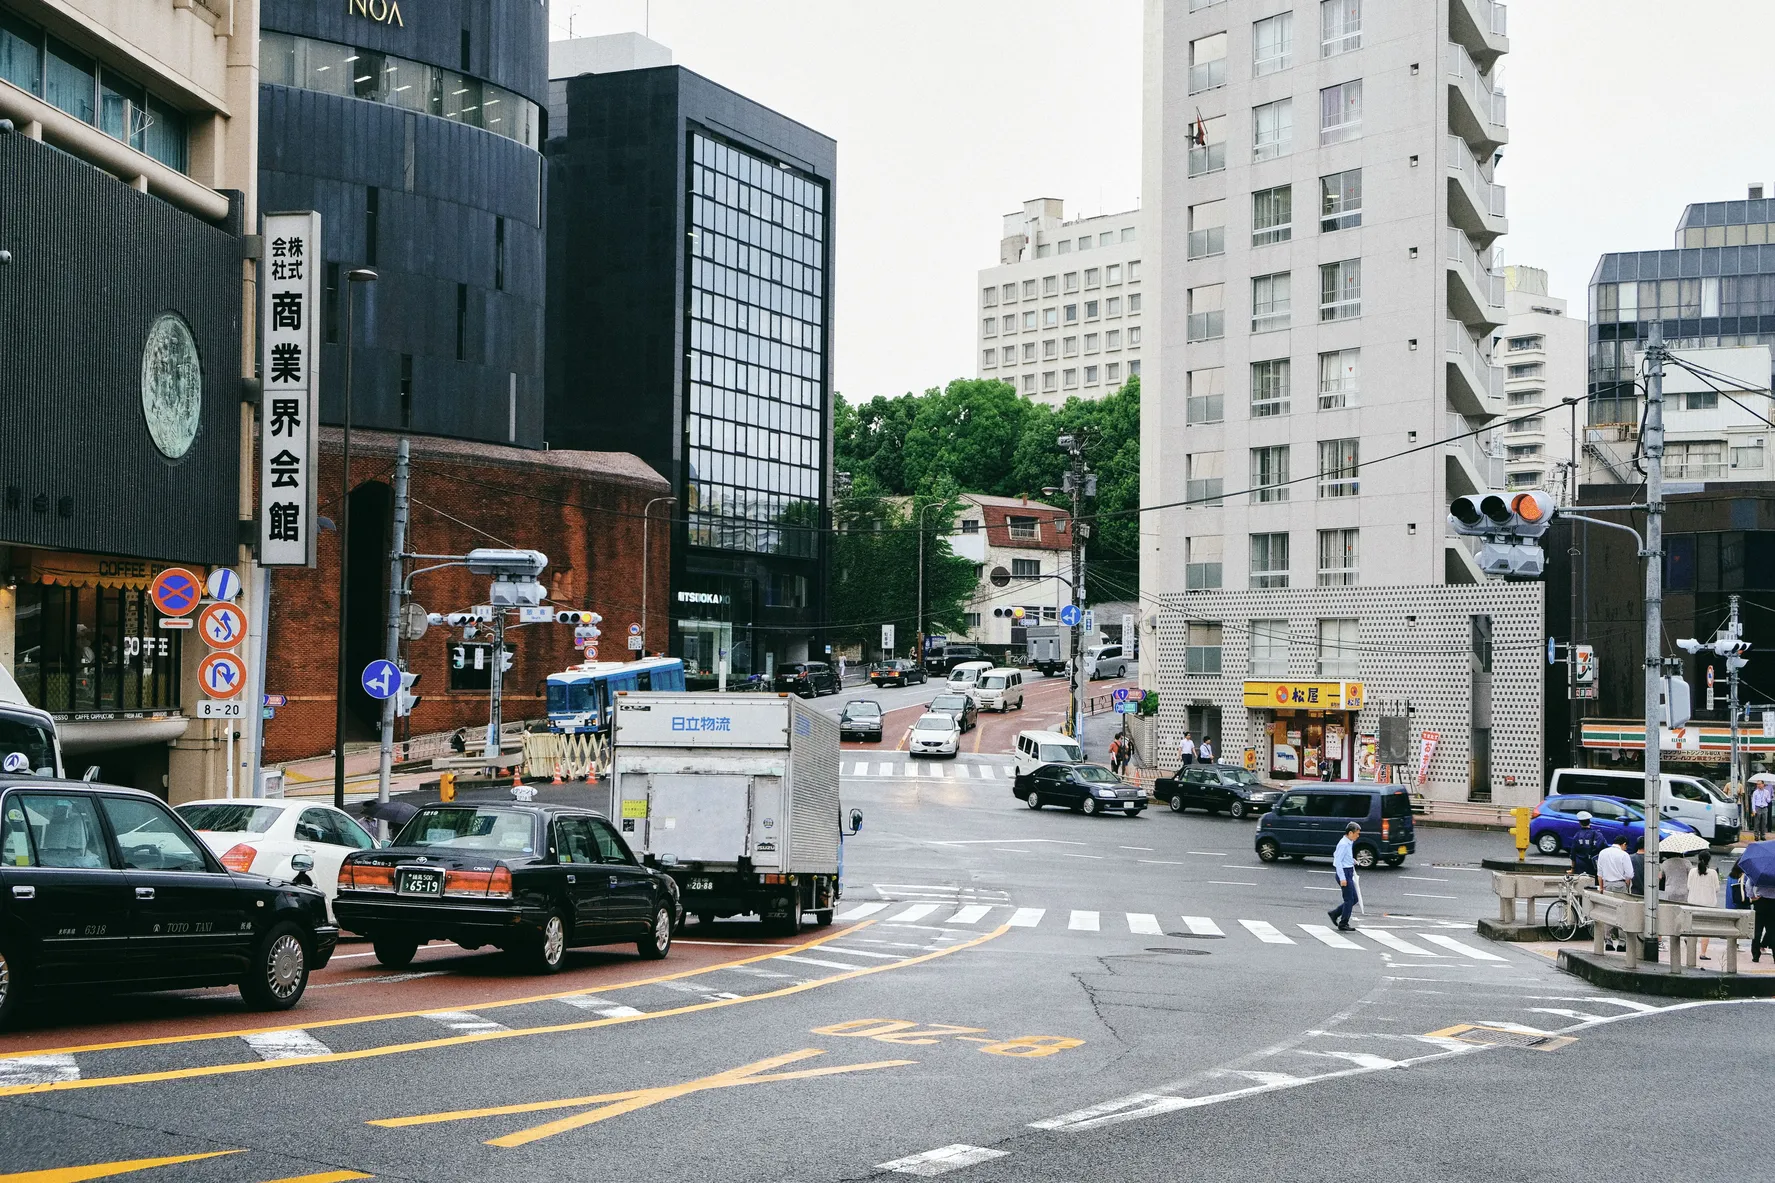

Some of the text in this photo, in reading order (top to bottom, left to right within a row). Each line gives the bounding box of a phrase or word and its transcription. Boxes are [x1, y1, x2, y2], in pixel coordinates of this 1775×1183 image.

[268, 291, 302, 541] 商業界会館
[99, 560, 146, 578] COFFEE
[1292, 687, 1319, 703] 松屋
[204, 704, 240, 715] 8-20
[671, 716, 731, 732] 日立物流
[410, 881, 438, 892] 65-19
[84, 925, 107, 935] 6318
[167, 922, 213, 933] TOTO TAXI
